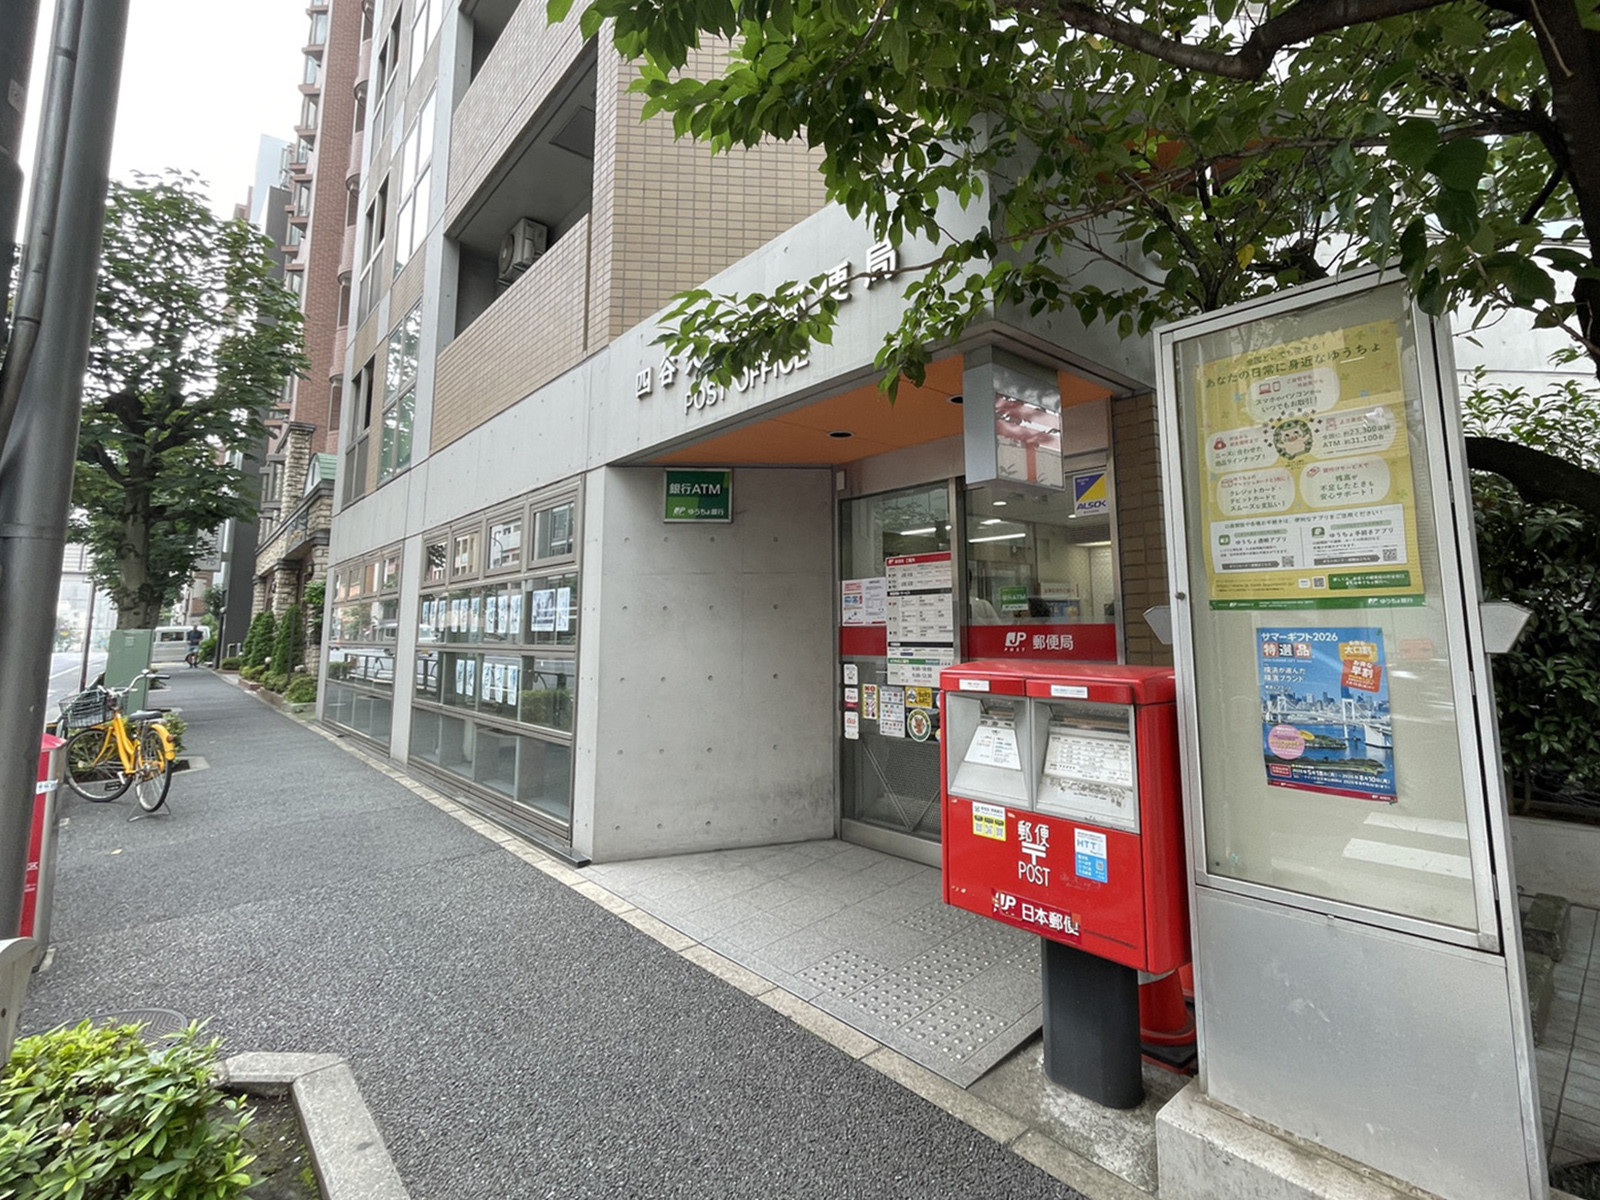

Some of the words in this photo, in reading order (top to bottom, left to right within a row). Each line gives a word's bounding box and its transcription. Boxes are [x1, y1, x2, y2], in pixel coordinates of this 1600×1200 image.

[1206, 343, 1381, 388] あなたの日常に身近なゆうちょ
[669, 483, 721, 494] 銀行ATM
[1076, 500, 1106, 510] ALSOK
[687, 508, 724, 516] ゆうちょ銀行
[1032, 633, 1074, 650] 郵便局
[1261, 632, 1338, 642] サマーギフト2026
[1263, 643, 1310, 657] 特選品
[1017, 820, 1050, 848] 郵便
[1077, 838, 1097, 850] HTT
[1018, 861, 1051, 887] POST
